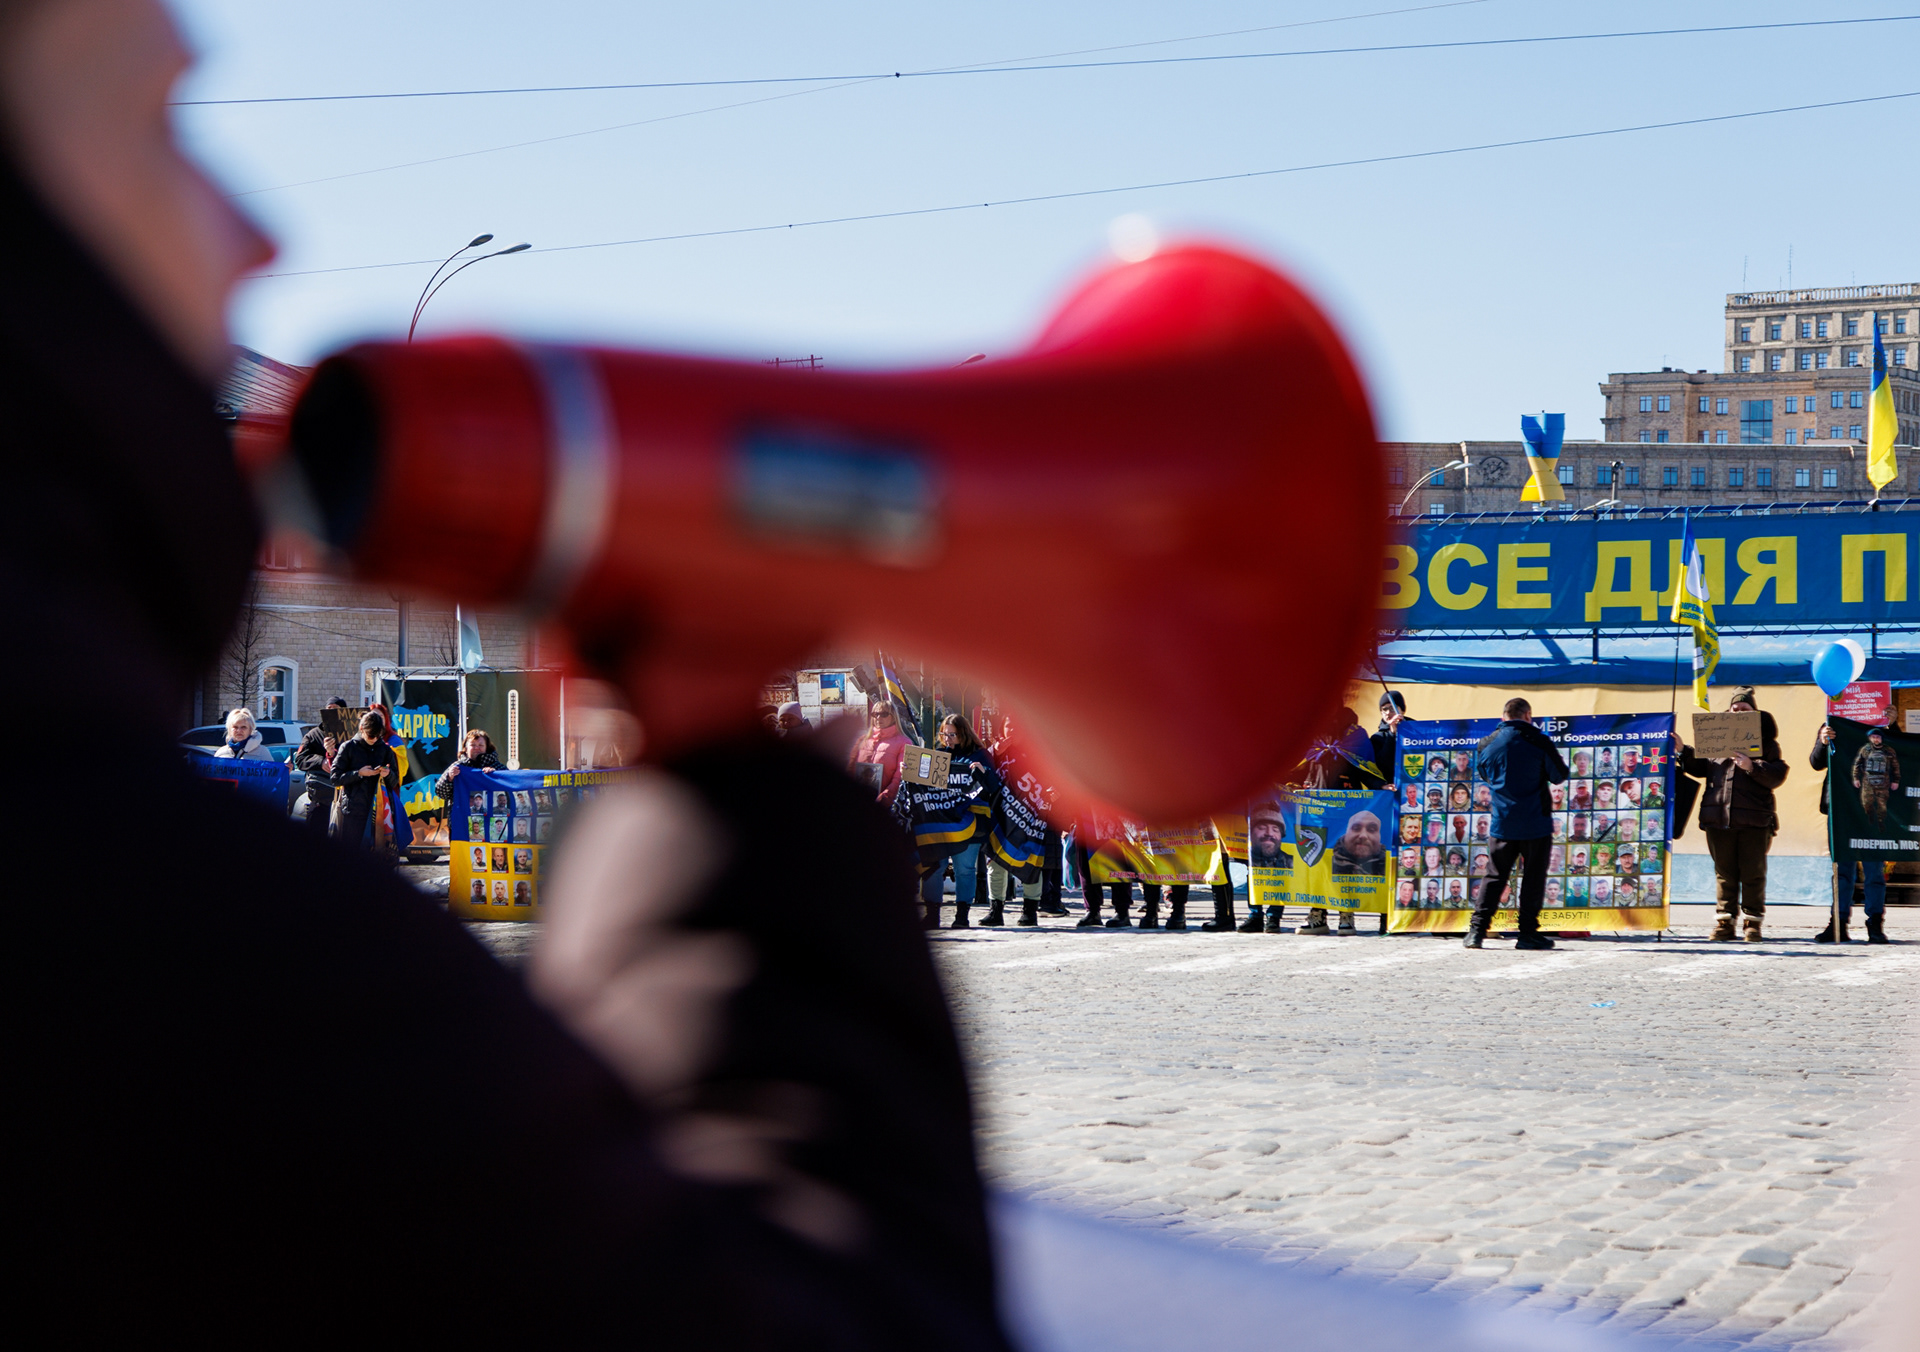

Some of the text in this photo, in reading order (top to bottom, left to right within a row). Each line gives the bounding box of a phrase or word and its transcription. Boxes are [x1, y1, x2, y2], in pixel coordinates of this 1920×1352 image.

[1376, 542, 1551, 610] ВСЕ
[1585, 536, 1798, 622] ДЛЯ
[1841, 532, 1920, 604] П
[394, 713, 447, 738] ХАРКІВ
[1533, 721, 1568, 732] МБР
[1402, 737, 1434, 746] Вони
[1436, 736, 1481, 747] бороли
[1564, 733, 1623, 744] боремося
[1641, 730, 1667, 739] них!
[543, 774, 559, 787] МИ
[560, 773, 572, 787] НЕ
[1017, 772, 1042, 803] 53
[1849, 838, 1920, 850] ПОВЕРНІТЬ МОЄ
[1328, 898, 1361, 909] ЧЕКАЄМО
[1552, 911, 1590, 920] ЗАБУТІ!
